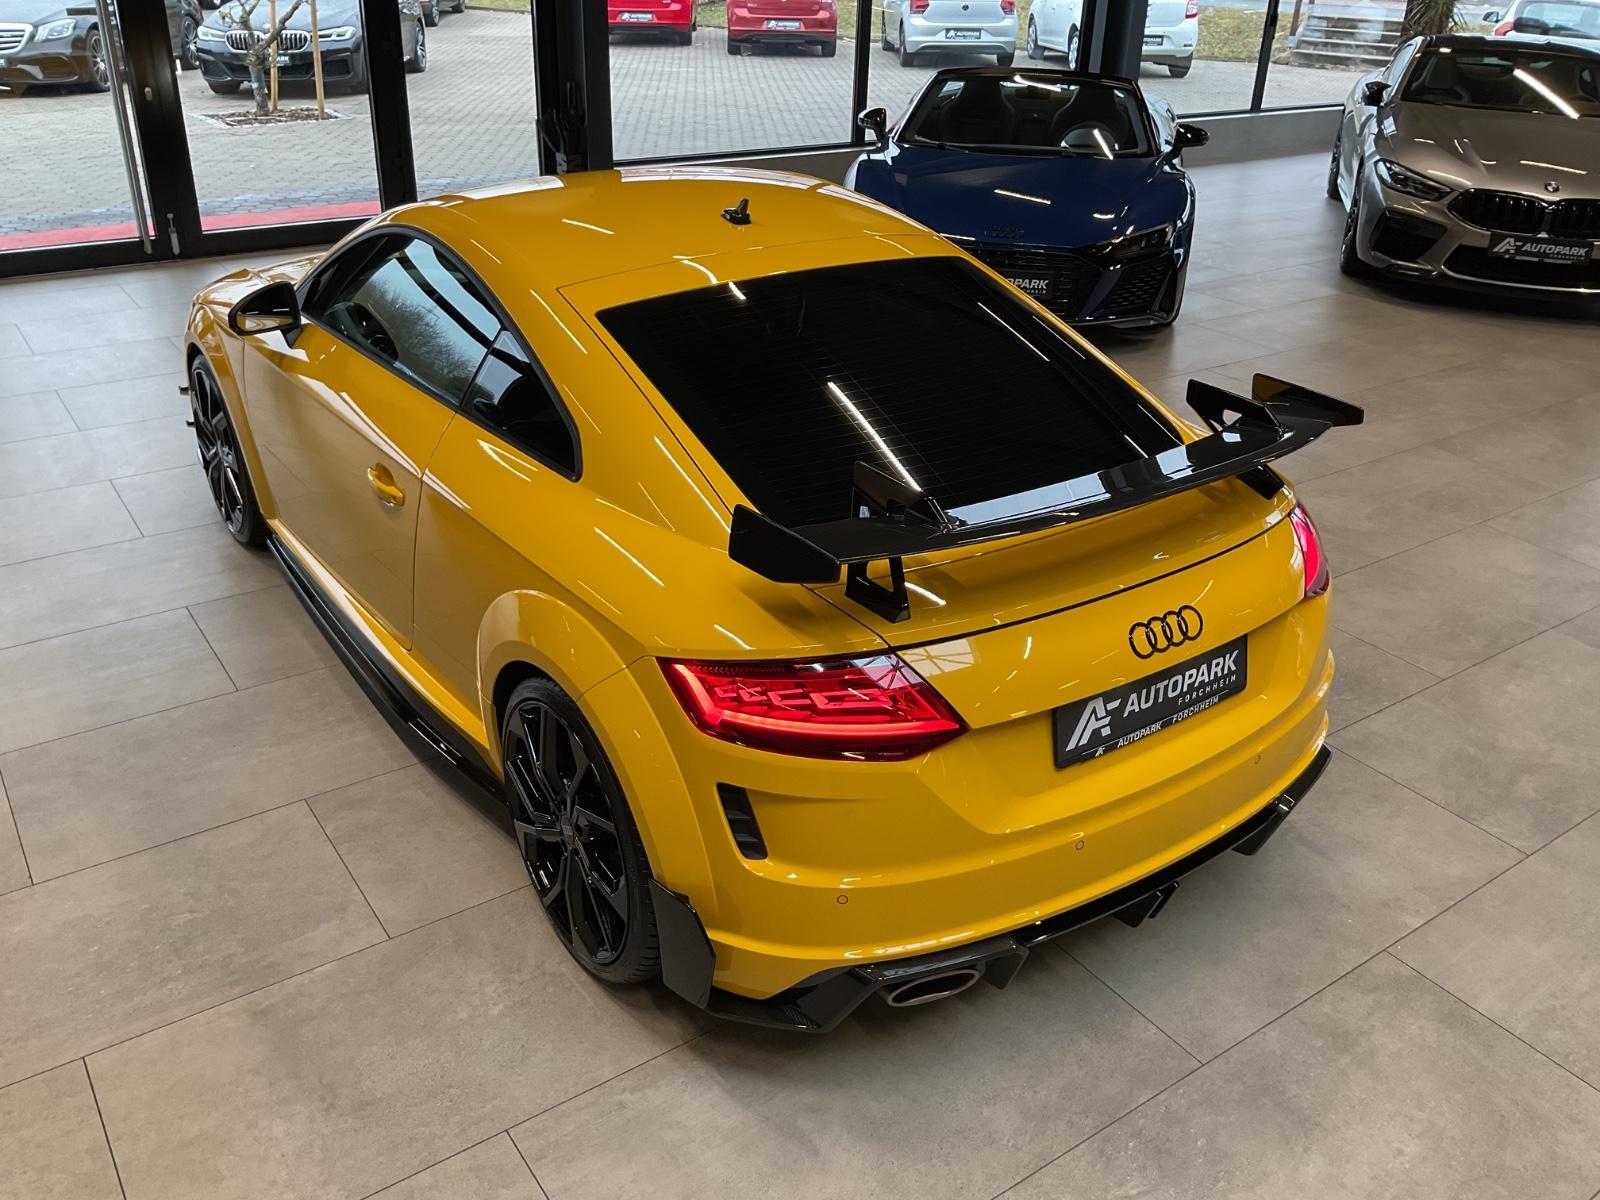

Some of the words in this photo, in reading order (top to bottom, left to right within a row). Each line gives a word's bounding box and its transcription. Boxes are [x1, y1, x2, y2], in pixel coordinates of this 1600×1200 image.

[1521, 243, 1589, 256] AUTOPARK
[1123, 650, 1239, 718] AUTOPARK
[1178, 675, 1237, 706] FORCHHEIM
[1117, 722, 1163, 748] AUTOPARK
[1172, 696, 1219, 724] FORCHHEIM
